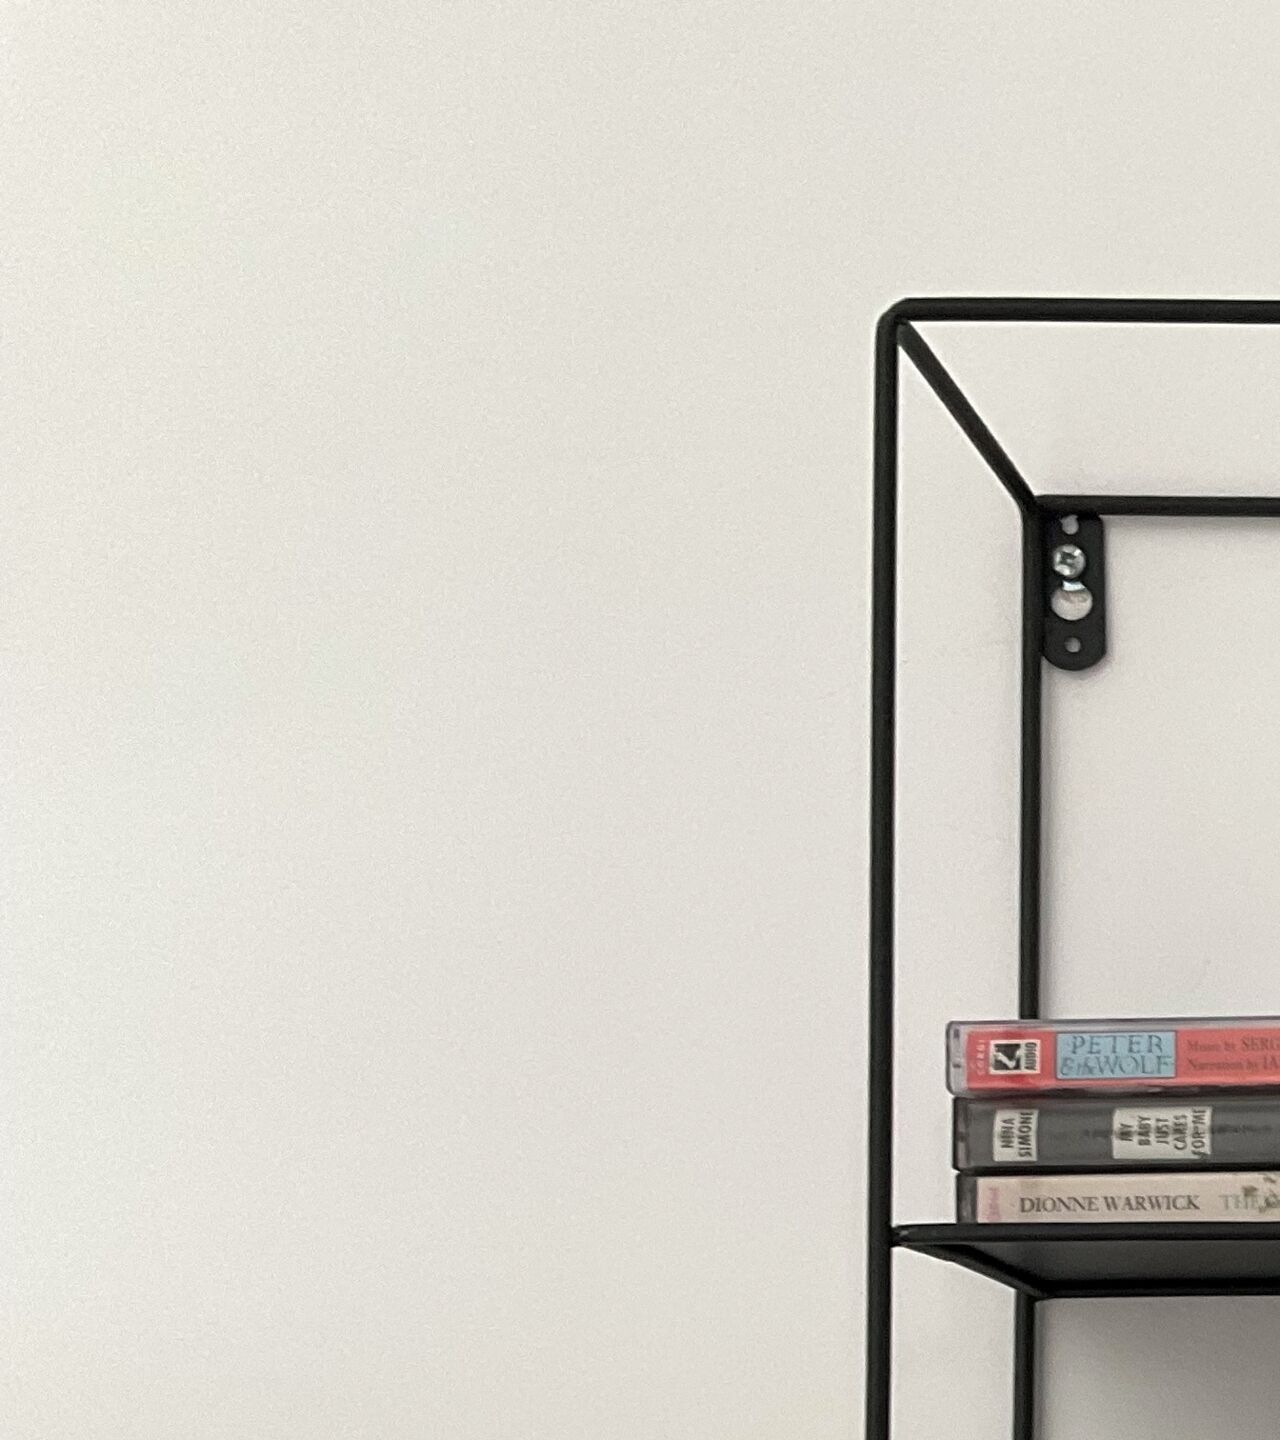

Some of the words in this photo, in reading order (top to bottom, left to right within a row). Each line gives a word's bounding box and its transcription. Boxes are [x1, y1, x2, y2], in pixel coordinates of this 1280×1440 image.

[1024, 1042, 1038, 1071] AUDIO
[1071, 1034, 1163, 1055] PETER
[1093, 1055, 1176, 1075] WOLF
[1001, 1118, 1016, 1149] NINA
[1018, 1111, 1033, 1157] SIMONE
[1138, 1115, 1152, 1146] BABY
[1154, 1117, 1170, 1145] JUST
[1173, 1114, 1188, 1150] CARES
[1019, 1196, 1100, 1213] DIONNE
[1103, 1195, 1201, 1212] WARWICK
[1218, 1194, 1259, 1210] THE
